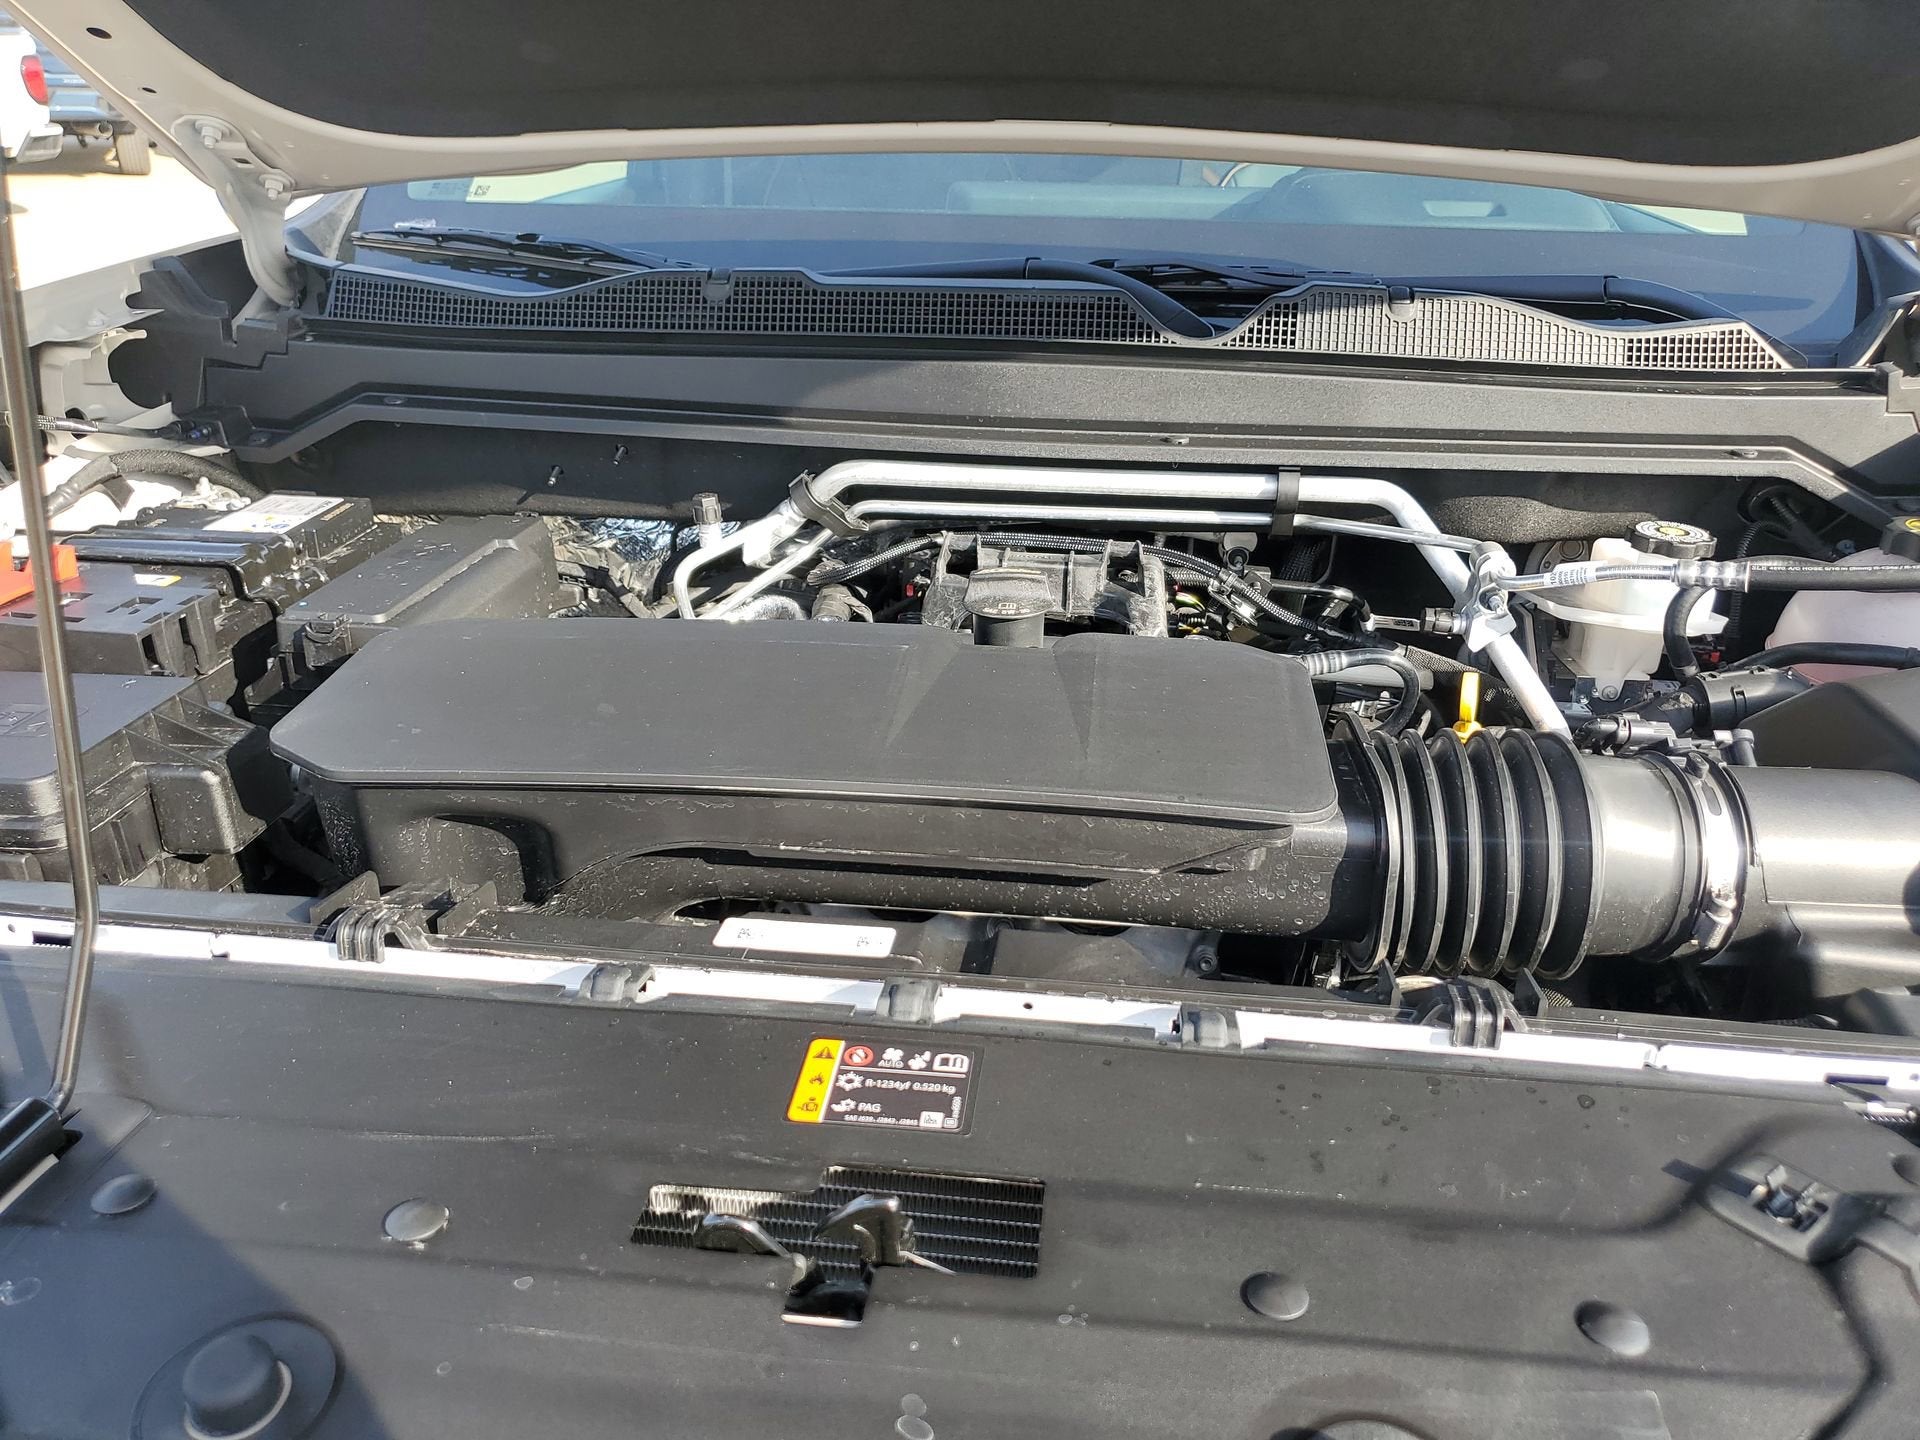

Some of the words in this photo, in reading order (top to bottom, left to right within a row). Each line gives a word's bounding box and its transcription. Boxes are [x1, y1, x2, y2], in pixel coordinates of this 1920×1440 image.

[877, 1059, 904, 1069] AUTO
[865, 1078, 912, 1091] R-1234yf
[913, 1081, 941, 1092] 0.520
[941, 1083, 957, 1095] kg
[857, 1102, 882, 1113] PAG
